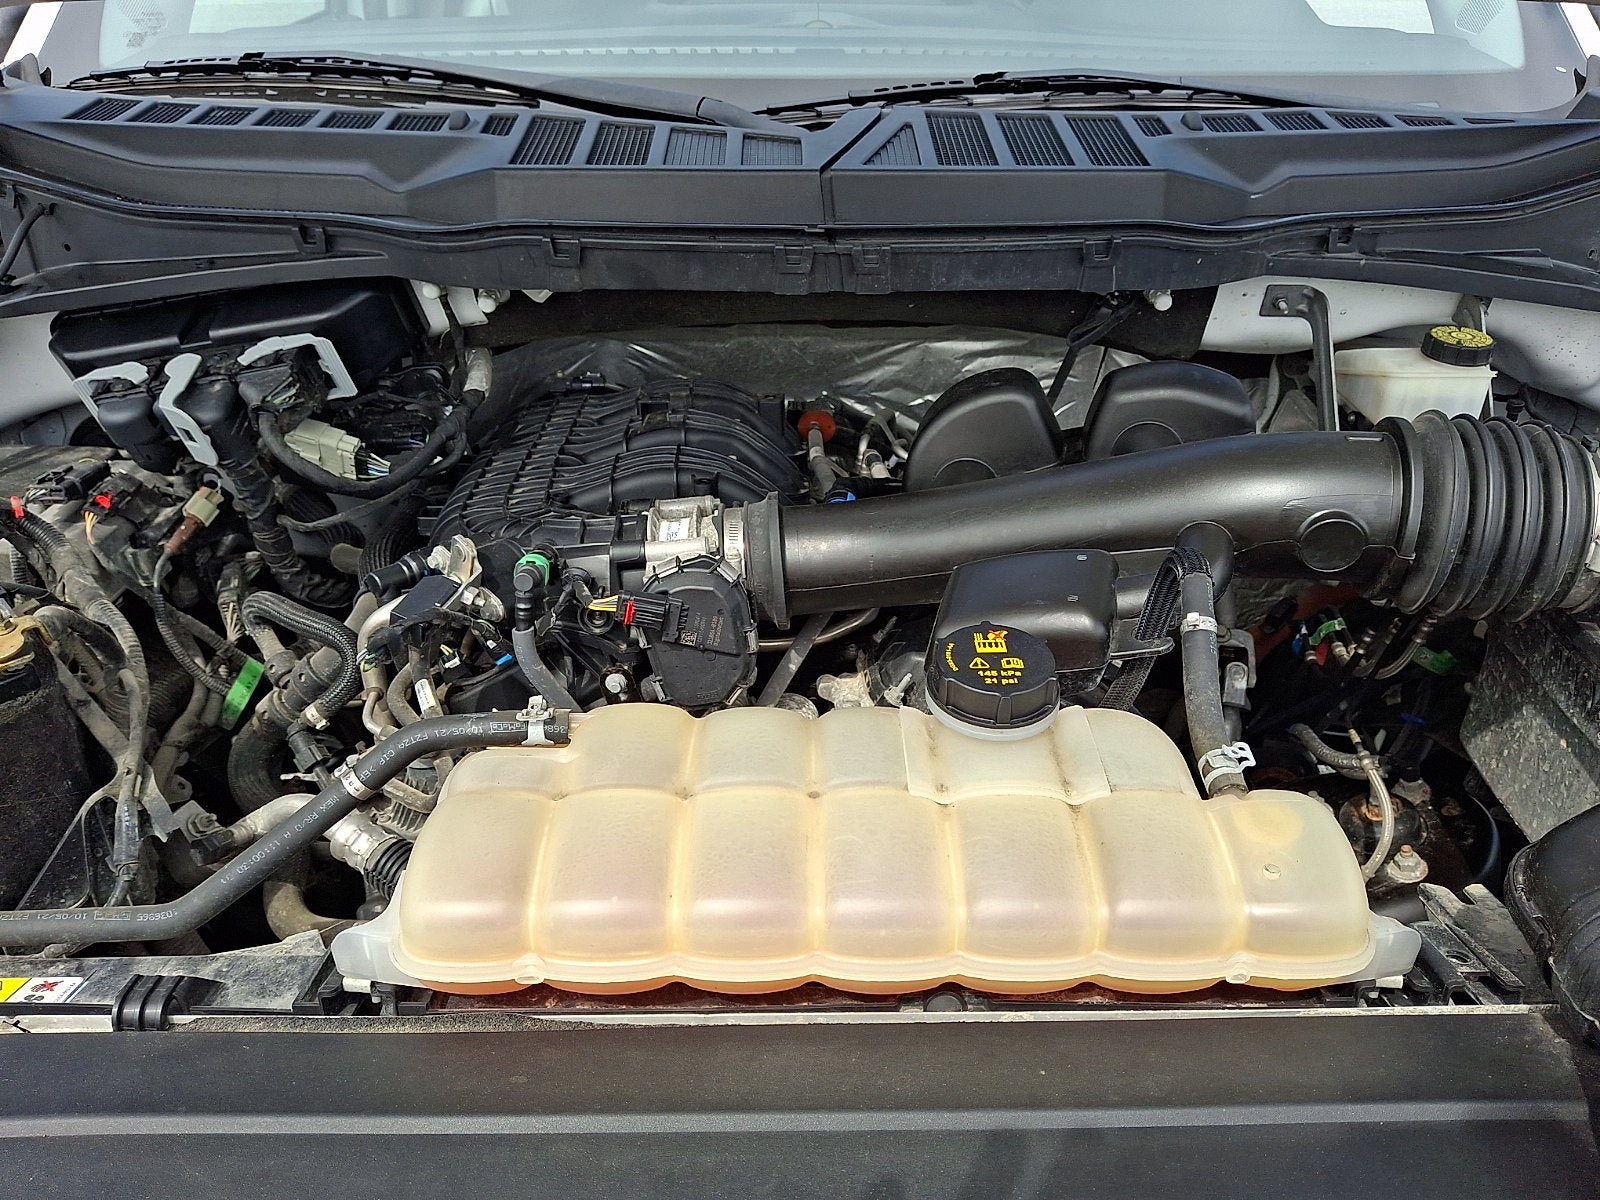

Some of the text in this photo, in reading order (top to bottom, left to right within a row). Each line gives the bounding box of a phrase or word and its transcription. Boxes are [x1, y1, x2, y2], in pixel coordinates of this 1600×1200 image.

[1001, 677, 1018, 685] psi
[434, 725, 483, 738] 10/05/21
[491, 723, 527, 732] FoMoCo
[320, 795, 340, 812] MEX
[37, 912, 88, 921] 10/05/21
